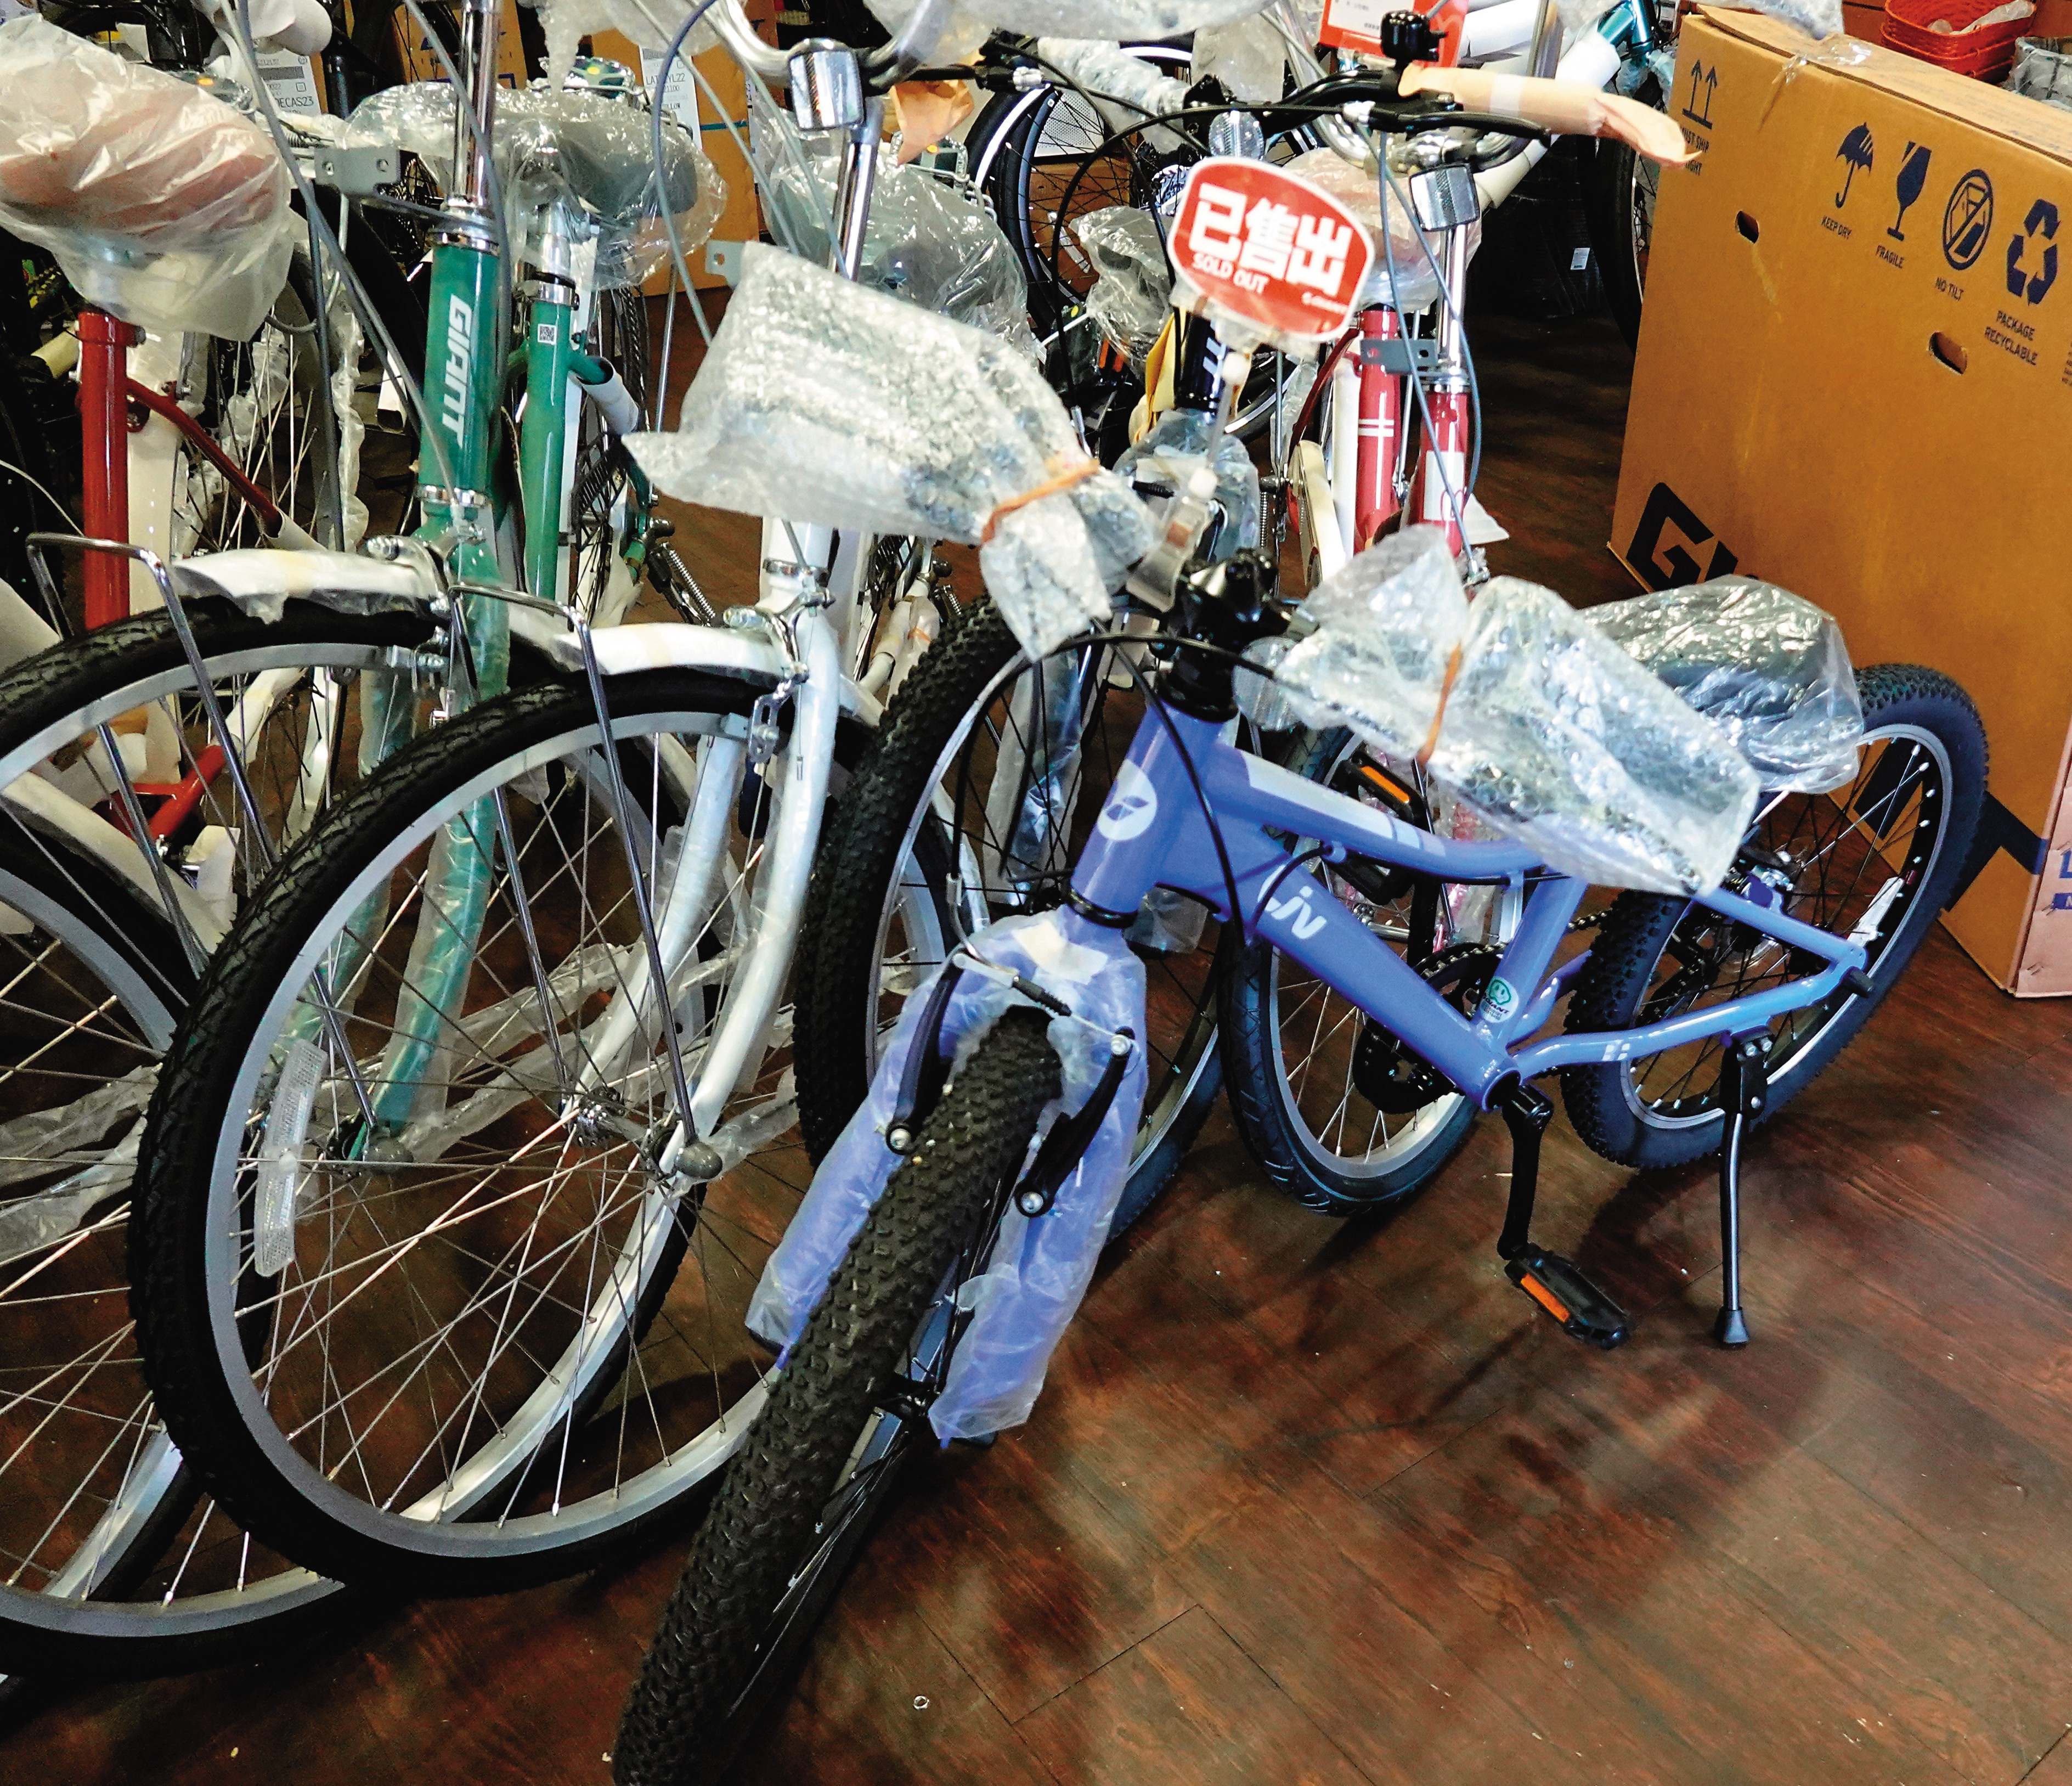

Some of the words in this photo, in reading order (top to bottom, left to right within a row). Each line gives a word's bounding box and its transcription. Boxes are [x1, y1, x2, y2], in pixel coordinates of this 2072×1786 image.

[1189, 182, 1353, 297] 已售出
[1821, 215, 1838, 232] KEEP
[1838, 224, 1852, 240] DRY
[1193, 252, 1234, 279] SOLD
[1233, 269, 1269, 294] OUT
[1875, 245, 1905, 269] FRAGILE
[1935, 277, 1947, 292] NO
[1949, 283, 1964, 301] TILT
[1996, 310, 2035, 341] PACKAGE
[1984, 326, 2038, 366] RECYCLABLE
[442, 293, 472, 449] GIANT
